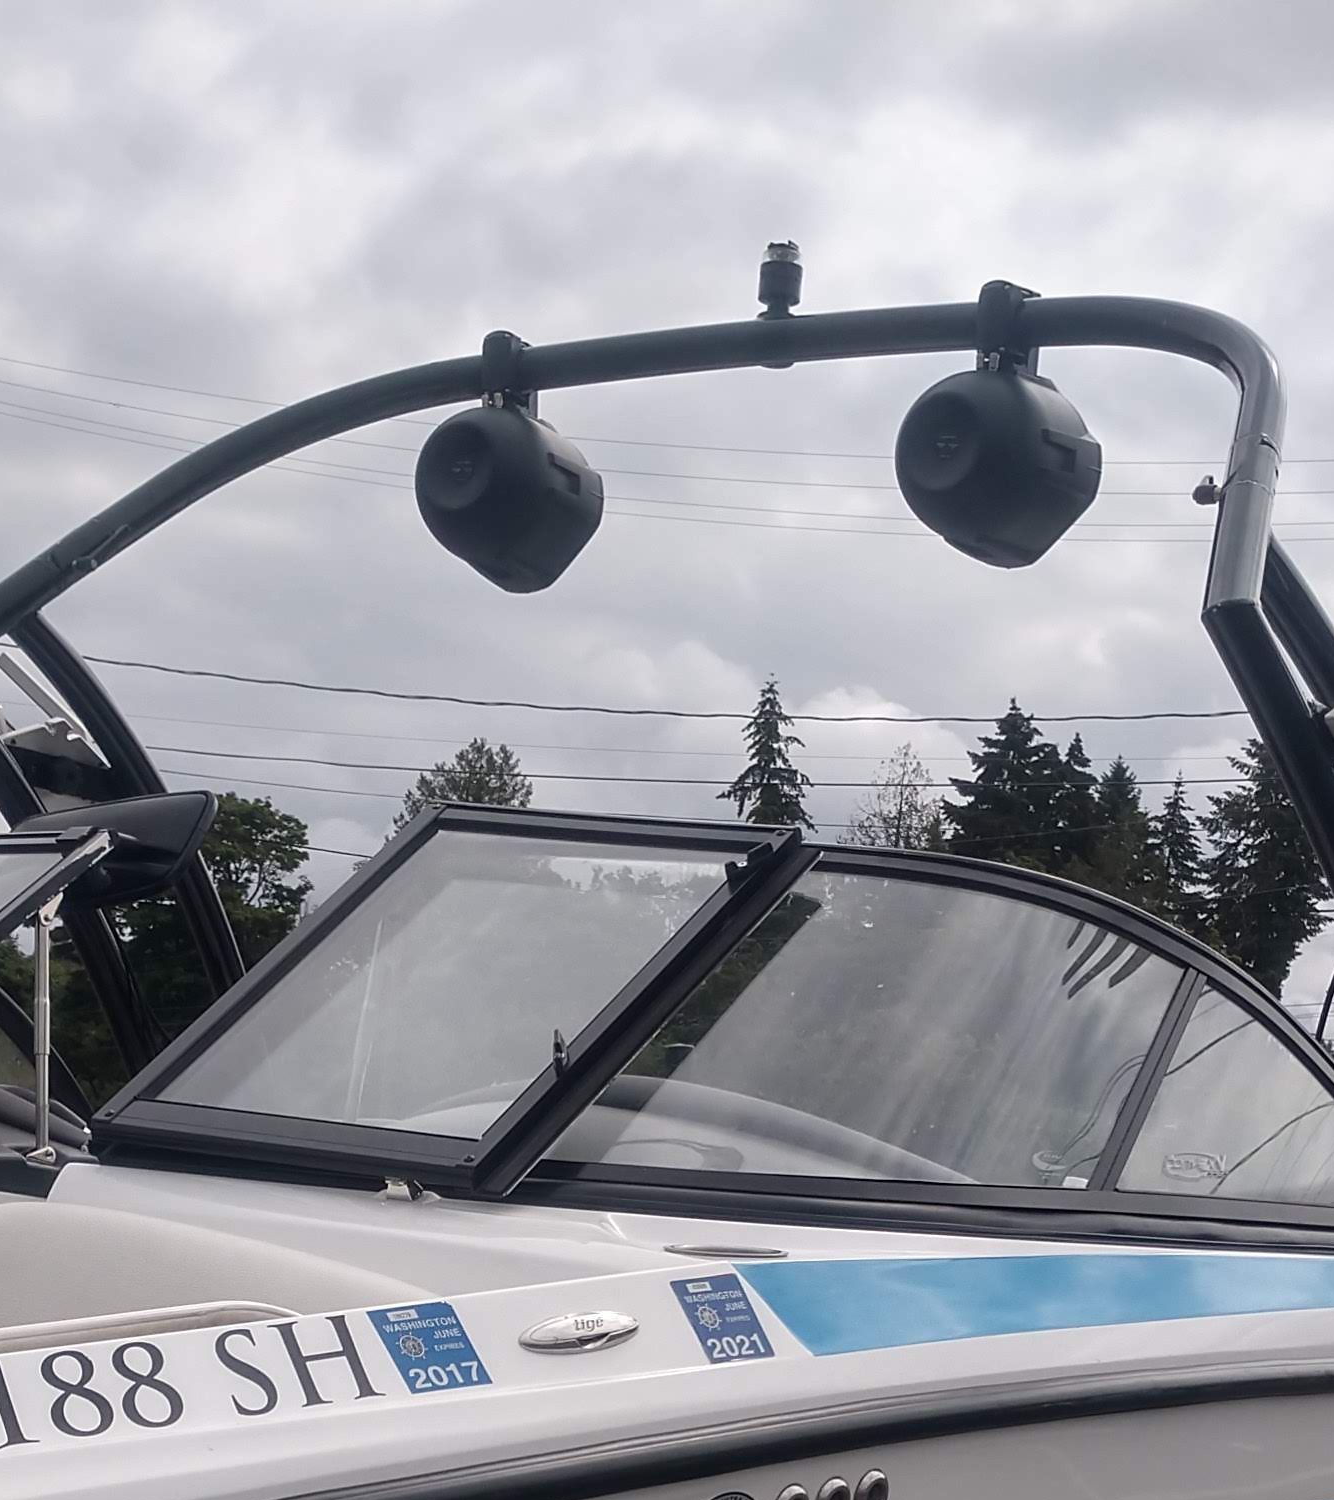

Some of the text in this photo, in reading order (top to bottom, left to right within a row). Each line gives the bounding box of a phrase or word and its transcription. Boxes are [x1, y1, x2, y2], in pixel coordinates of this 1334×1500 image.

[683, 1288, 743, 1303] WASHINGTON
[382, 1315, 457, 1333] WASHINGTON
[433, 1328, 462, 1339] JUNE
[707, 1333, 765, 1359] 2021
[215, 1313, 387, 1416] SH
[409, 1360, 480, 1389] 2017
